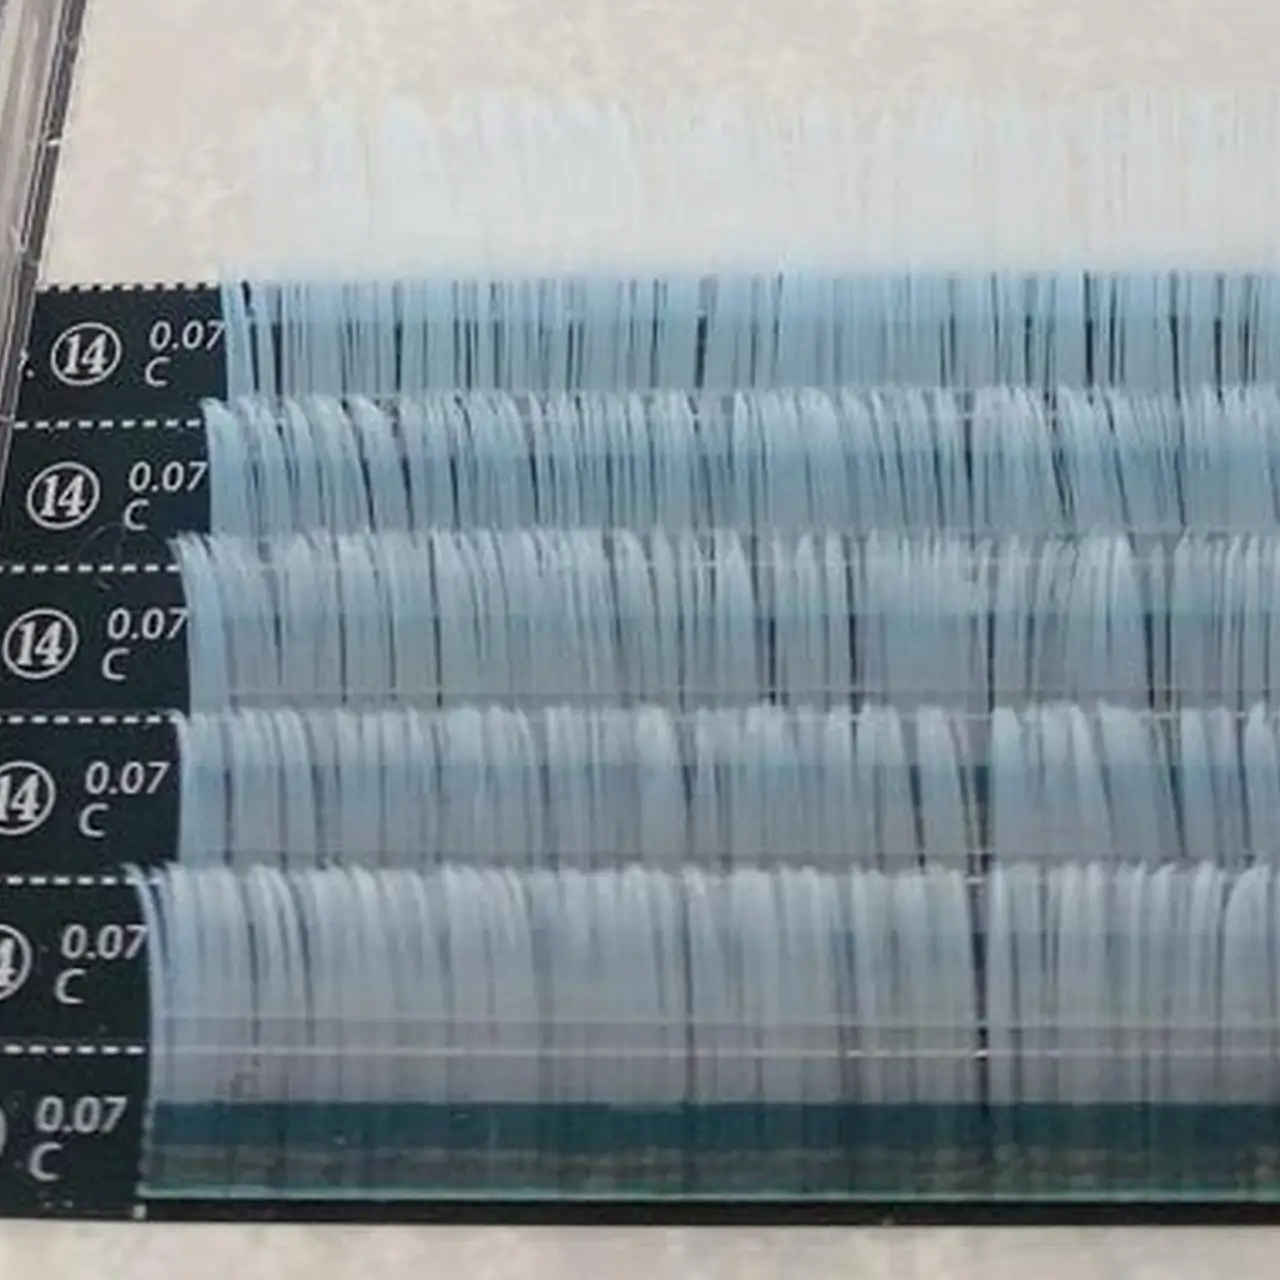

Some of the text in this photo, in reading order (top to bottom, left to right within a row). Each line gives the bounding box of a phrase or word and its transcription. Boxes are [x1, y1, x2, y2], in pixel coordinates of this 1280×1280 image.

[149, 320, 223, 351] 0.07
[144, 356, 171, 387] C
[128, 461, 208, 493] 0.07
[123, 499, 151, 531] C
[107, 607, 189, 640] 0.07
[101, 647, 130, 681] C
[84, 761, 169, 795] 0.07
[78, 802, 110, 838] C
[60, 924, 148, 959] 0.07
[54, 968, 87, 1004] C
[35, 1096, 127, 1133] 0.07
[29, 1142, 64, 1182] C
